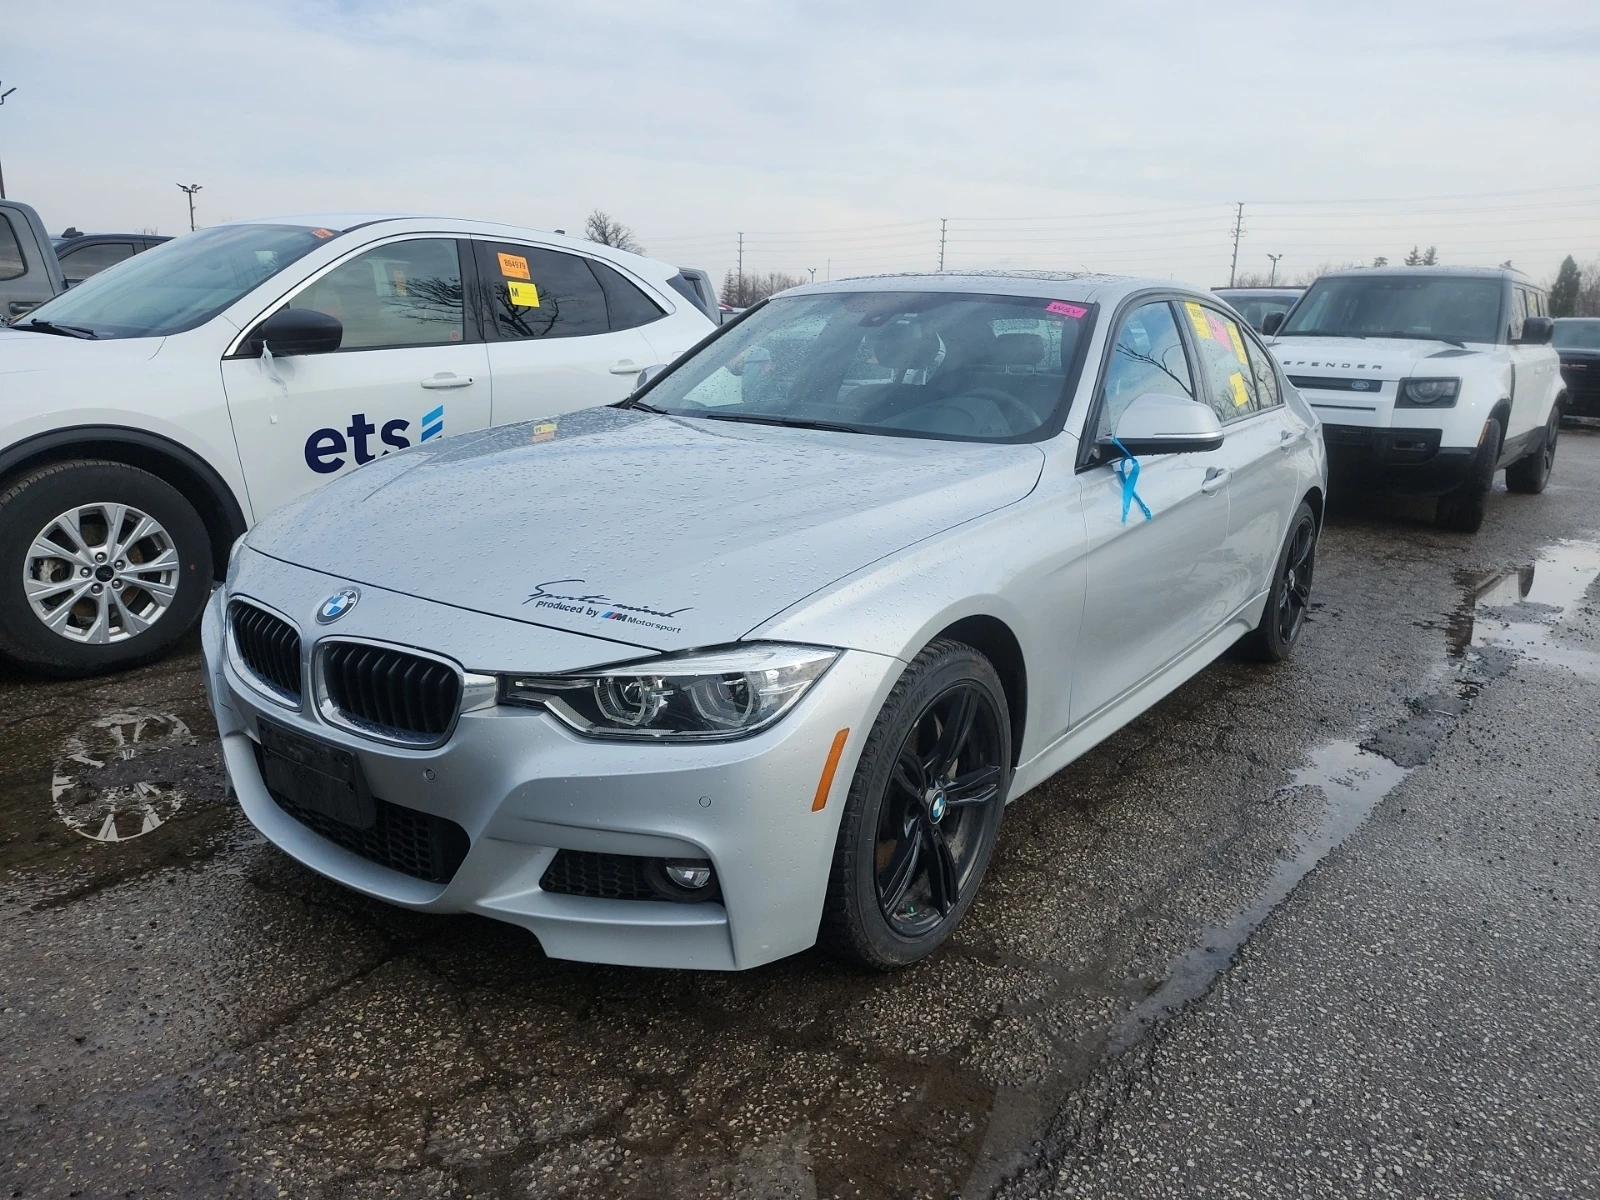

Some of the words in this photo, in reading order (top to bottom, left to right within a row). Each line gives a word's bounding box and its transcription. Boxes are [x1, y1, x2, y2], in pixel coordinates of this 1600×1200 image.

[511, 287, 520, 298] M
[1283, 360, 1383, 370] EFENDER
[304, 413, 411, 474] ets
[535, 599, 584, 615] produced
[585, 607, 600, 618] by
[627, 616, 682, 634] Motorsport
